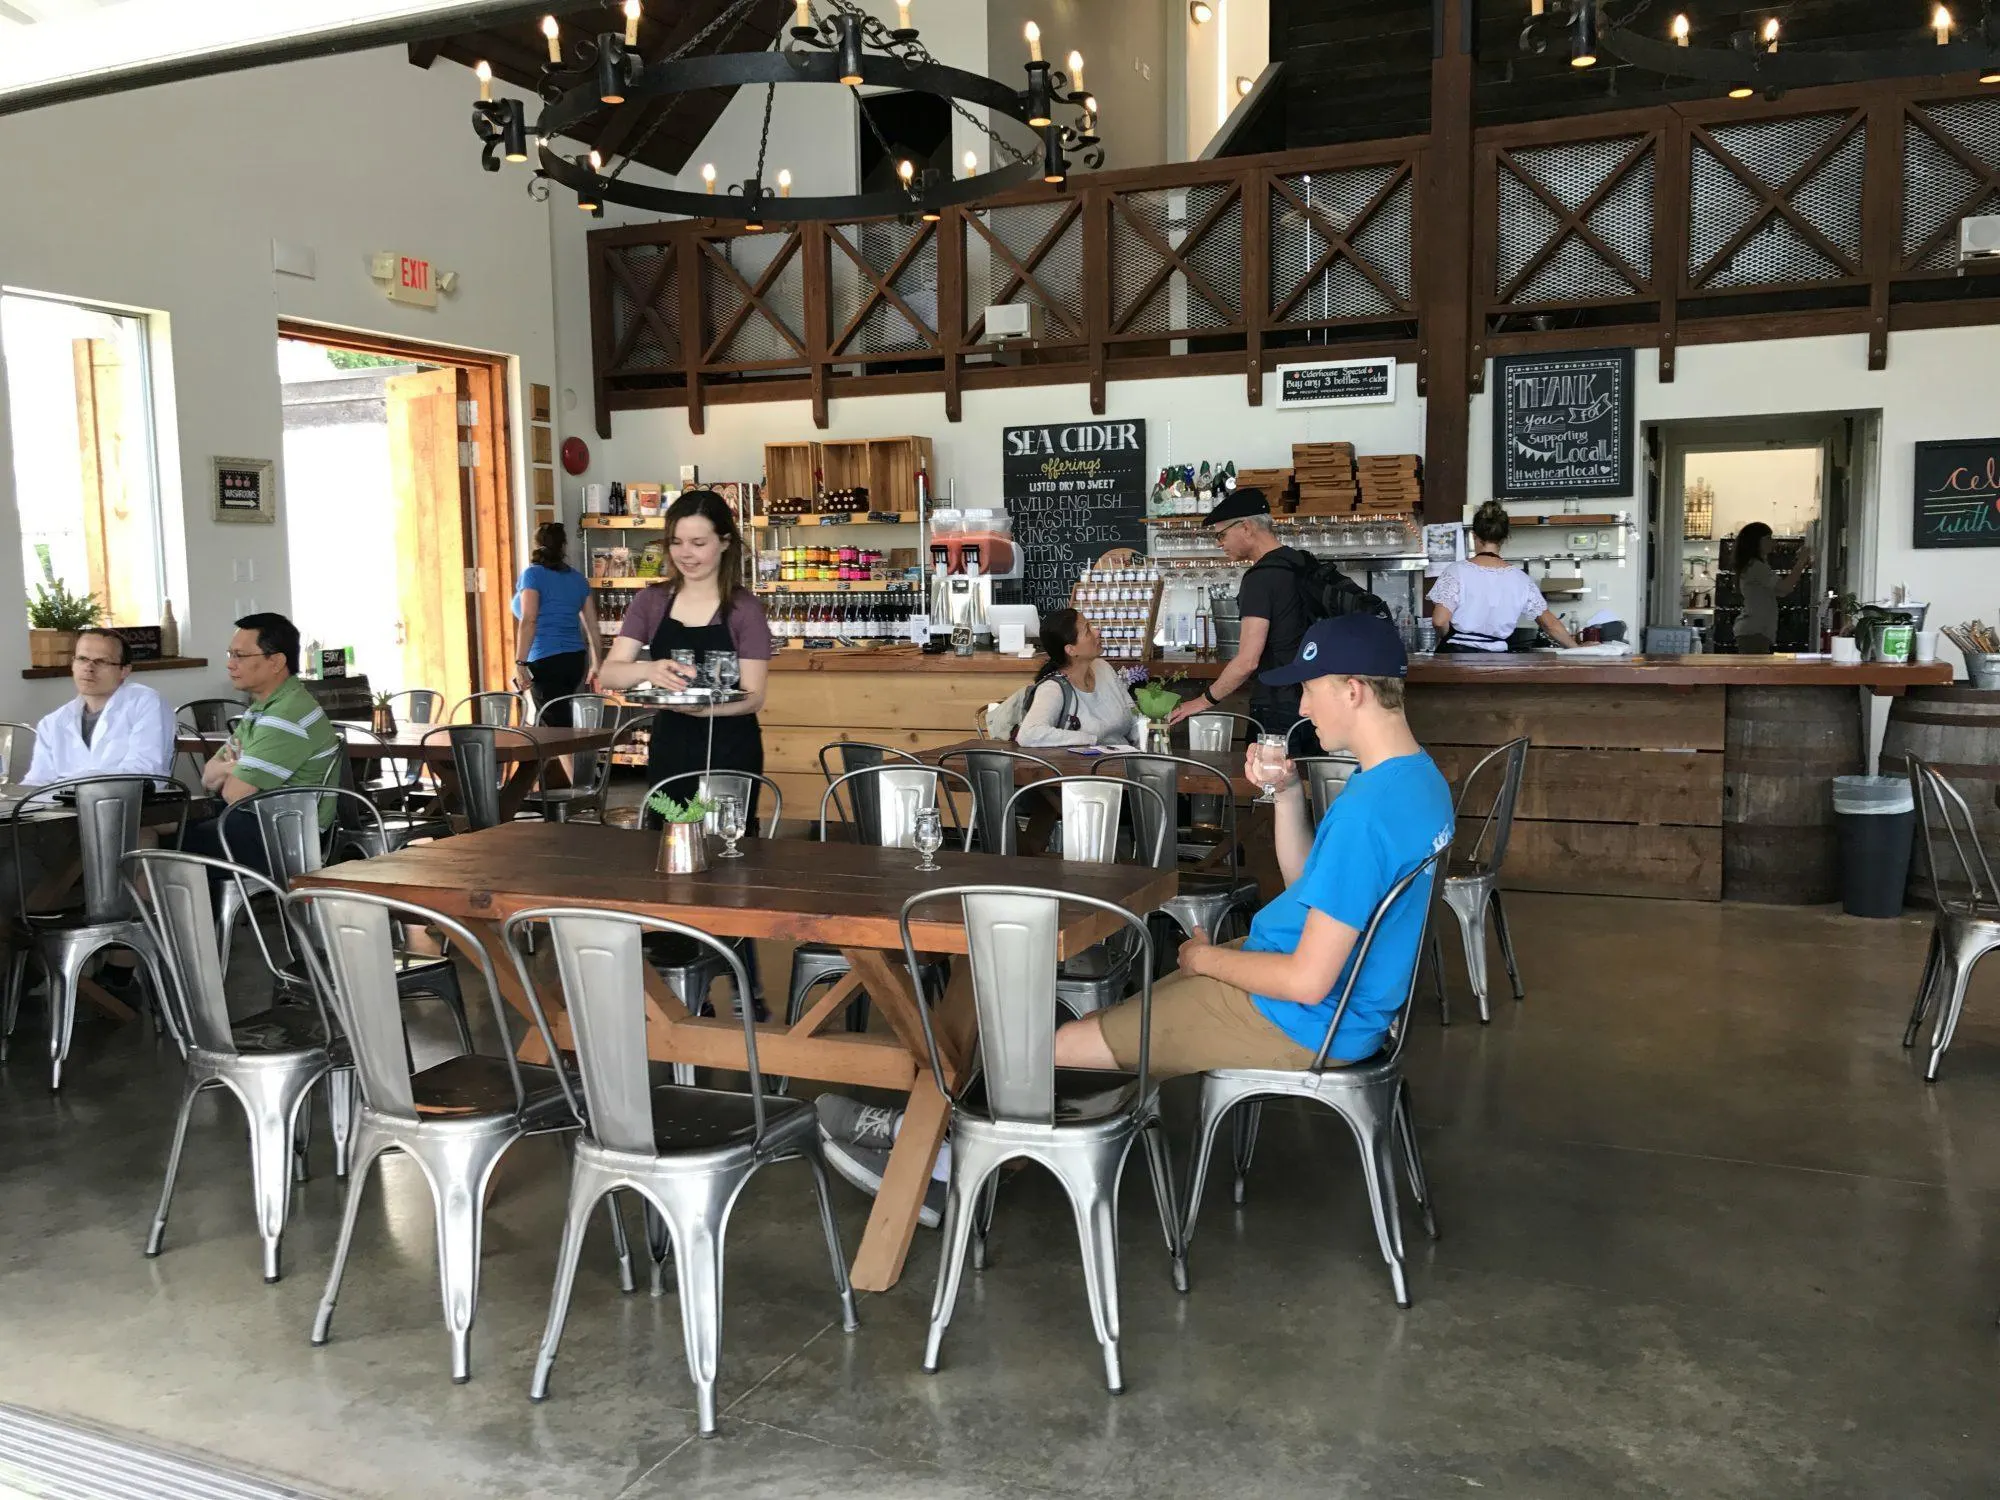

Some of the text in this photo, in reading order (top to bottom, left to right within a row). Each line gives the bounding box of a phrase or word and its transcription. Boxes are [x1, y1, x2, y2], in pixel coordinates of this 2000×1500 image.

[401, 257, 429, 291] EXIT
[1286, 380, 1302, 389] Buy
[1305, 379, 1320, 389] any
[1324, 377, 1331, 386] 3
[1514, 374, 1597, 409] THANK
[1516, 414, 1564, 433] you
[1007, 423, 1140, 456] SEA CIDER
[1527, 430, 1588, 449] Supporting
[1041, 457, 1101, 479] offerings
[1029, 479, 1116, 492] LISTED DRY TO SWEET
[1019, 496, 1054, 512] WILD
[1060, 494, 1122, 510] ENGLISH
[1020, 509, 1093, 529] FLAGSHIP
[1019, 529, 1061, 545] KINGS
[1075, 525, 1121, 542] SPIES
